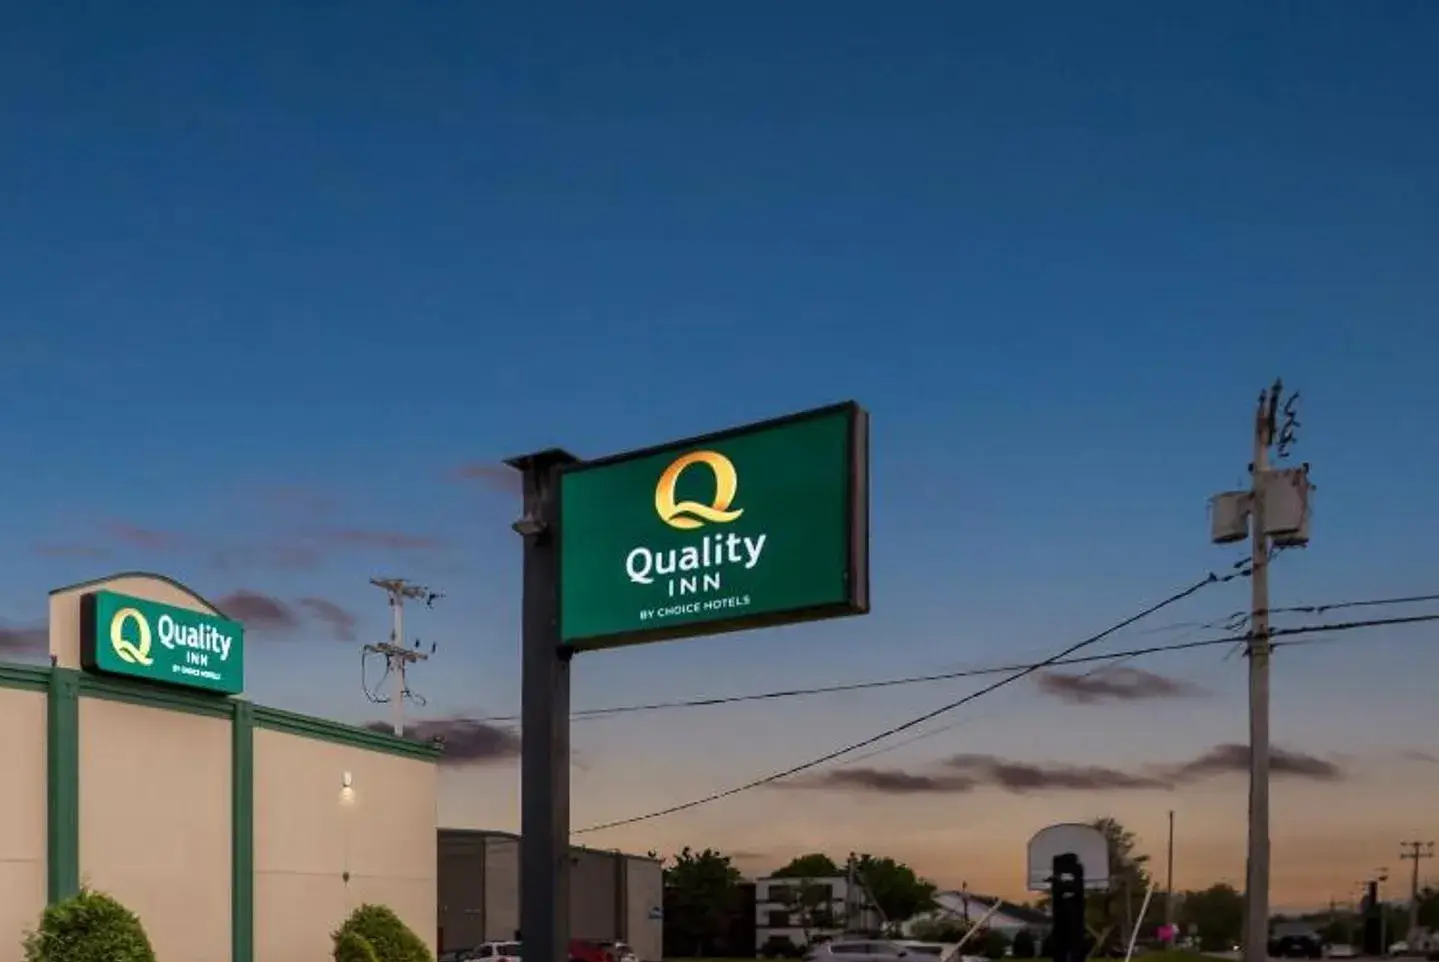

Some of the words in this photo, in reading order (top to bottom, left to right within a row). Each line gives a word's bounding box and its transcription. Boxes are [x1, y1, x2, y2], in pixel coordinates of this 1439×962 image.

[625, 533, 766, 584] Quality
[668, 572, 721, 597] INN
[640, 610, 655, 620] BY
[657, 602, 701, 617] CHOICE
[703, 595, 751, 610] HOTELS
[158, 614, 232, 661] Quality
